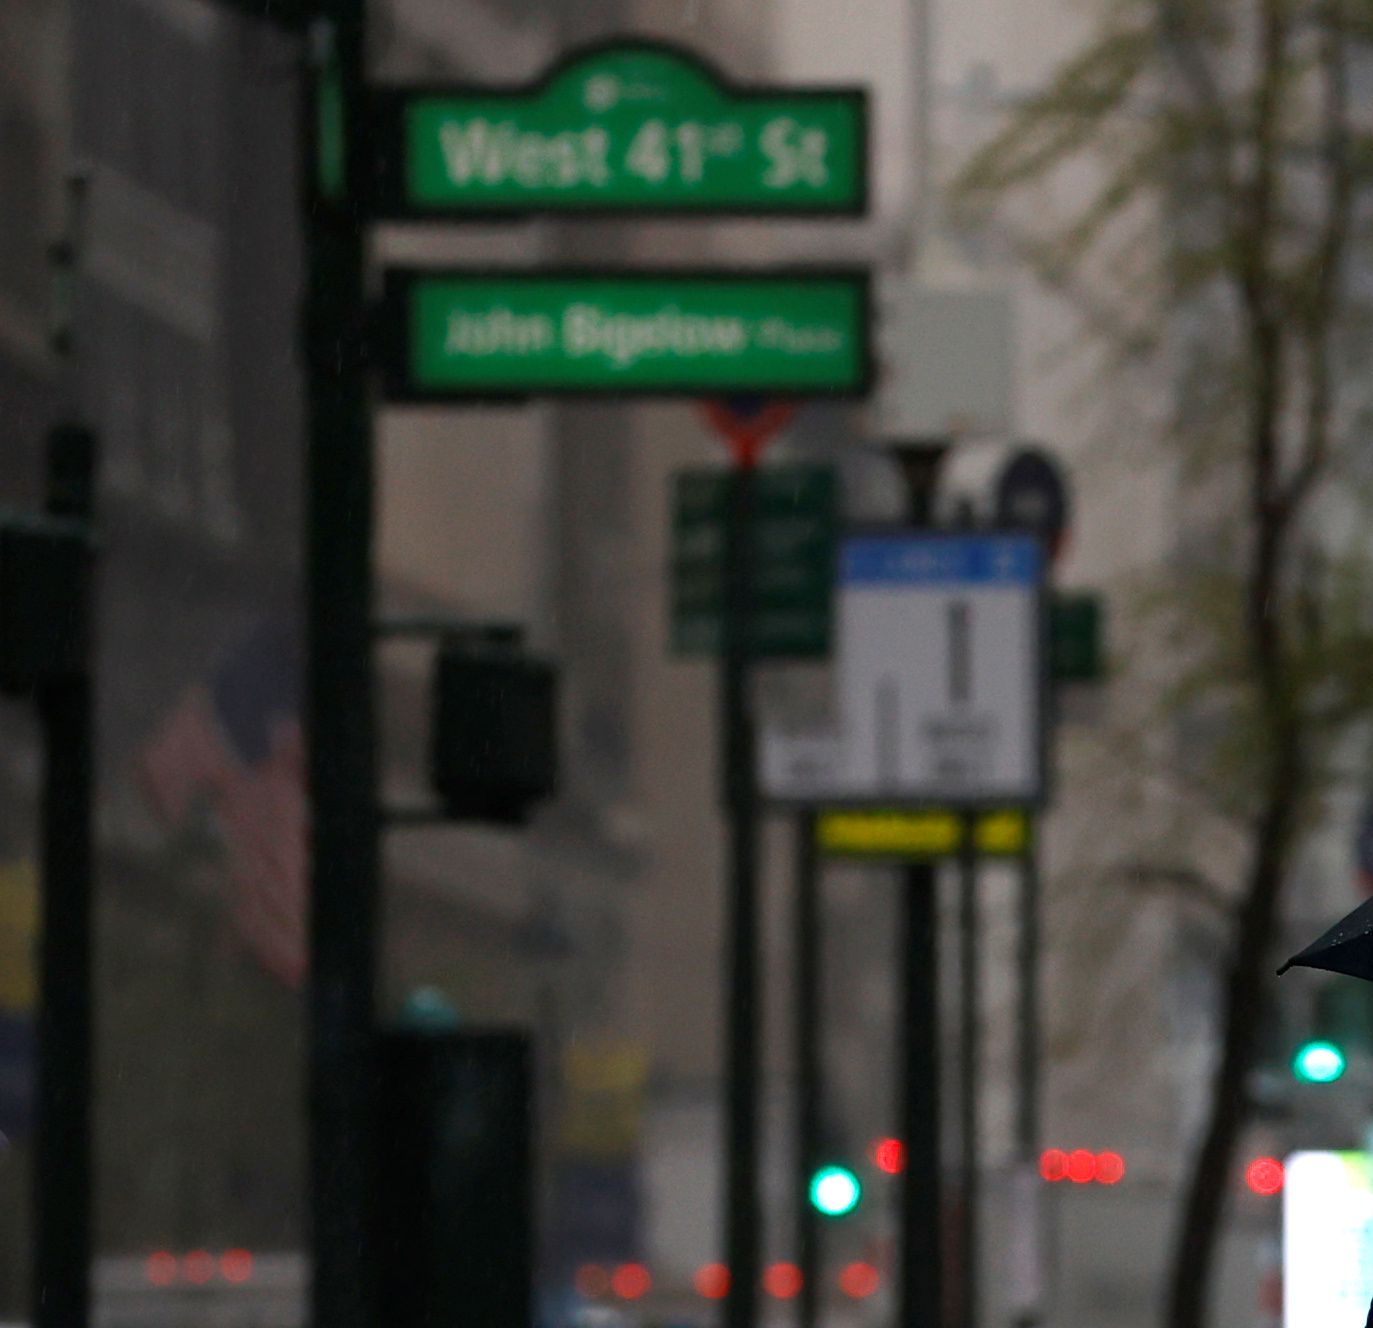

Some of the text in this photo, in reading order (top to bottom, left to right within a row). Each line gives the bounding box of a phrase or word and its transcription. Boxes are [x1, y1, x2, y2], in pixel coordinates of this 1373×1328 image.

[441, 118, 612, 188] West
[759, 117, 829, 189] St
[446, 306, 555, 355] John
[563, 304, 748, 369] Bigelow
